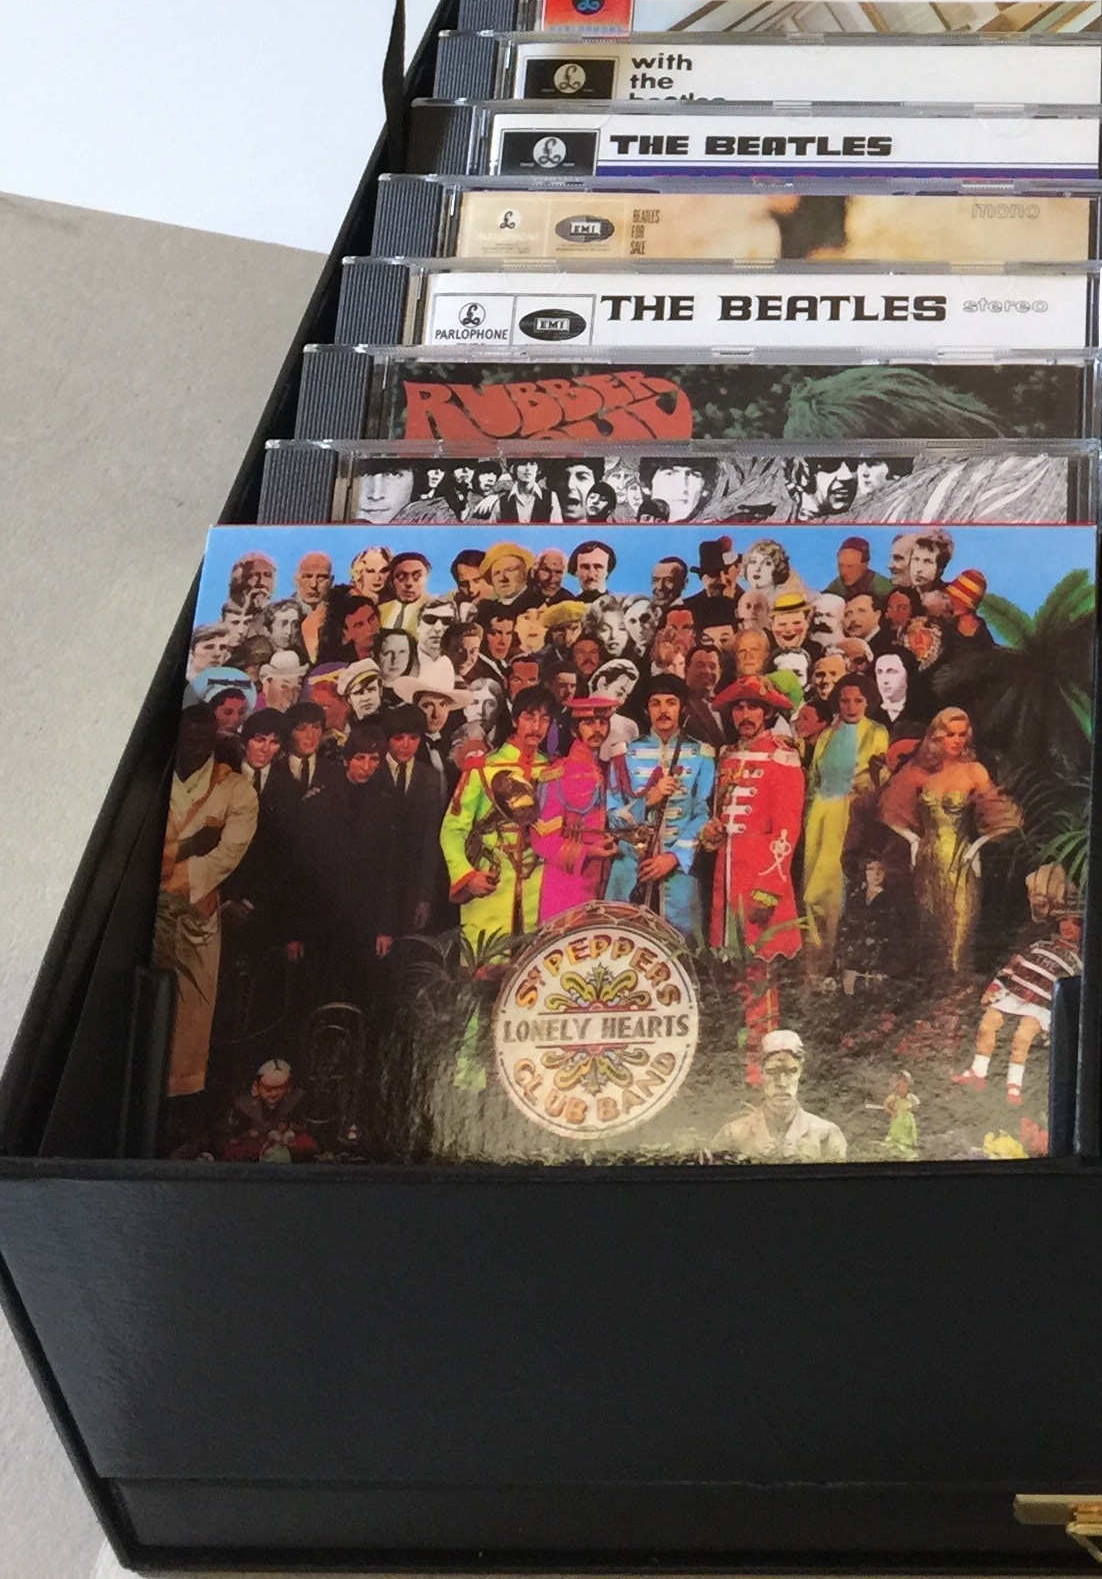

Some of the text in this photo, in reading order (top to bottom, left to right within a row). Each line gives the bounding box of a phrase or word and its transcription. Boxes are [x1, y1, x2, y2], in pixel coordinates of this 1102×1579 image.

[630, 52, 693, 71] with
[629, 72, 674, 90] the
[609, 134, 893, 157] THE BEATLES
[632, 209, 661, 224] BEATLES
[971, 203, 1041, 219] mono
[631, 225, 645, 239] FOR
[629, 241, 646, 255] SALE
[601, 295, 947, 322] THE BEATLES
[962, 297, 1049, 314] stereo
[434, 327, 509, 341] PARLOPHONE
[539, 321, 566, 331] EMI
[402, 371, 678, 440] RUBBER
[502, 1014, 690, 1043] LONELY HEARTS
[513, 1052, 677, 1124] CLUB BAND
